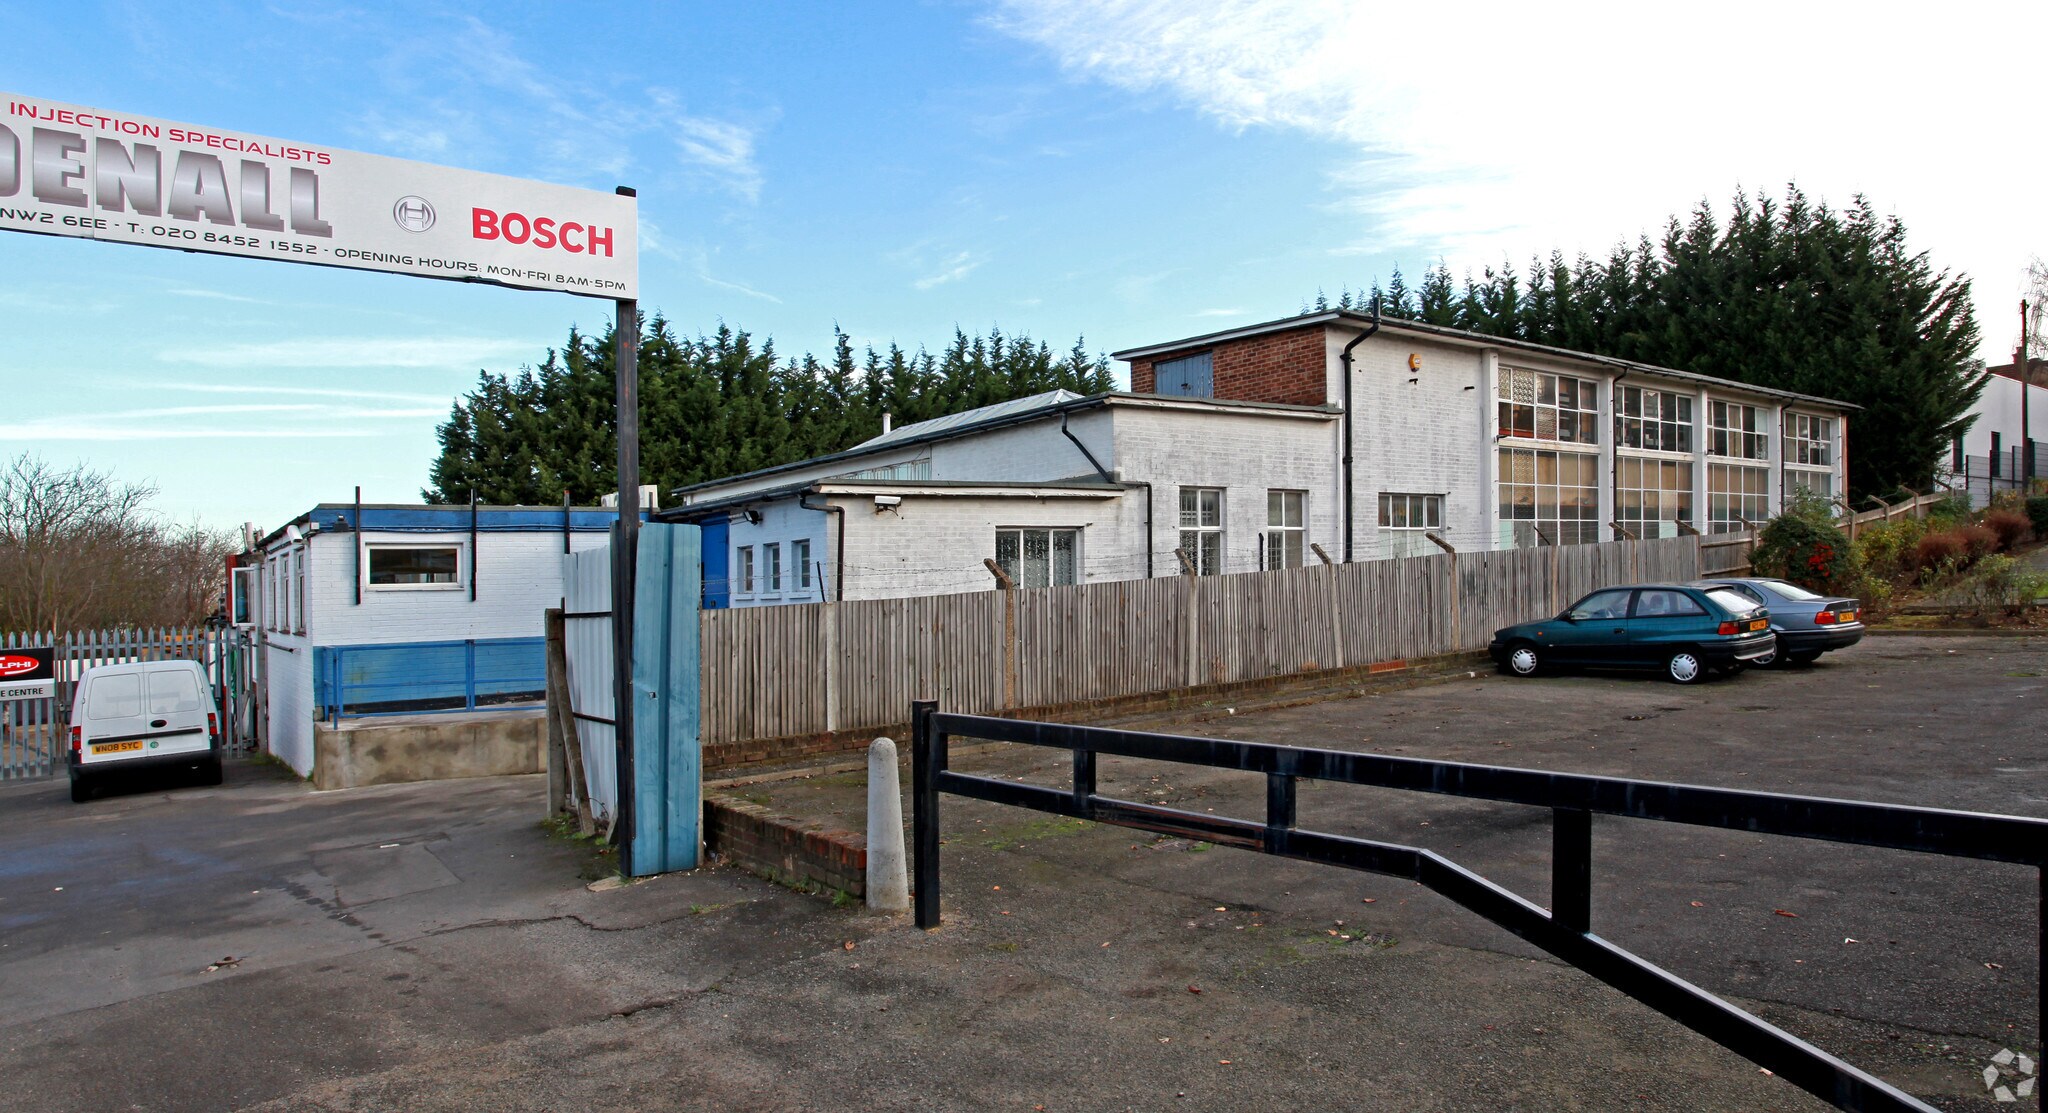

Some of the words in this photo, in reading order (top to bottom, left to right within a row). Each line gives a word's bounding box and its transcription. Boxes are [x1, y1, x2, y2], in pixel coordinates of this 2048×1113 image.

[10, 101, 160, 139] INJECTION
[169, 128, 332, 166] SPECIALISTS
[0, 207, 55, 224] NW2
[62, 215, 108, 230] 6EE
[127, 222, 145, 234] T:
[151, 225, 197, 241] 020
[203, 231, 260, 248] 8452
[270, 240, 318, 255] 1552
[334, 248, 414, 266] OPENING
[418, 257, 482, 273] HOURS:
[487, 264, 551, 282] MON-FRI
[555, 273, 627, 291] 8AM-5PM
[472, 207, 614, 258] BOSCH
[8, 688, 43, 696] CENTRE
